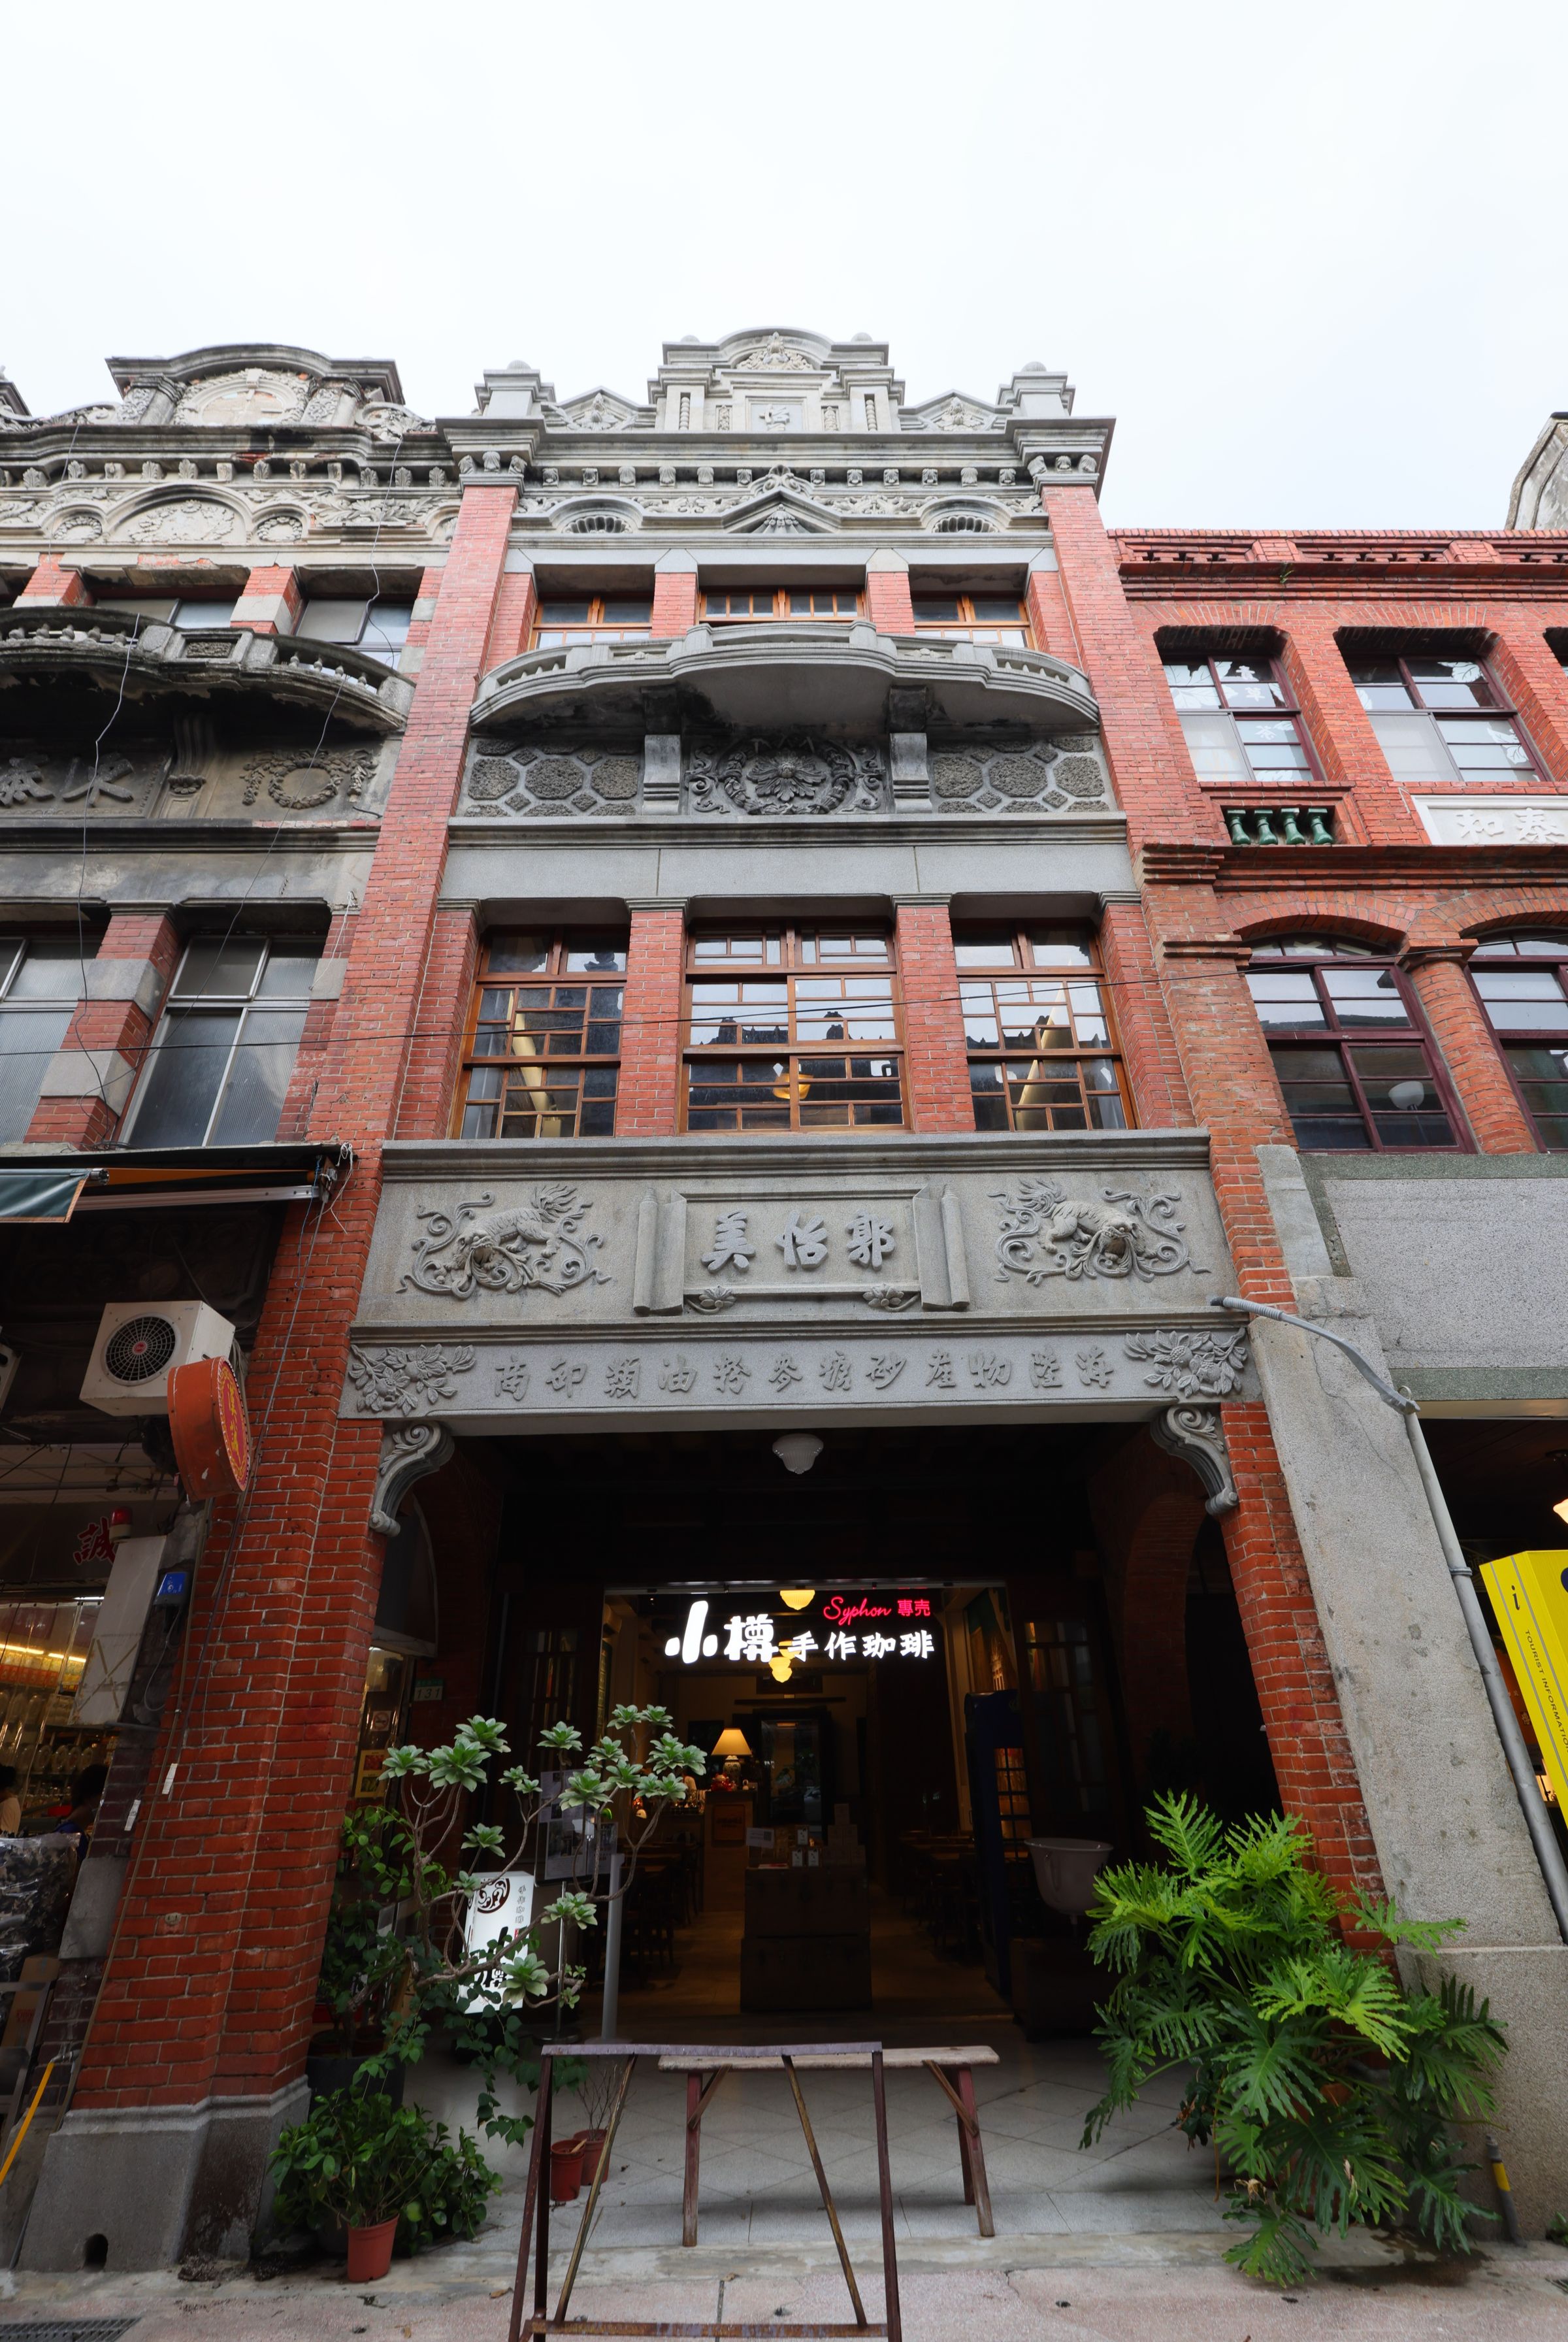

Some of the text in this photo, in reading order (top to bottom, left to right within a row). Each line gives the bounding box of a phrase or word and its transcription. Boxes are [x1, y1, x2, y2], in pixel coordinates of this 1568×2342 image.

[1235, 665, 1276, 740] 青草茶
[823, 1596, 892, 1626] Syphon
[1525, 1629, 1545, 1674] TOURIST
[417, 1688, 440, 1700] 131
